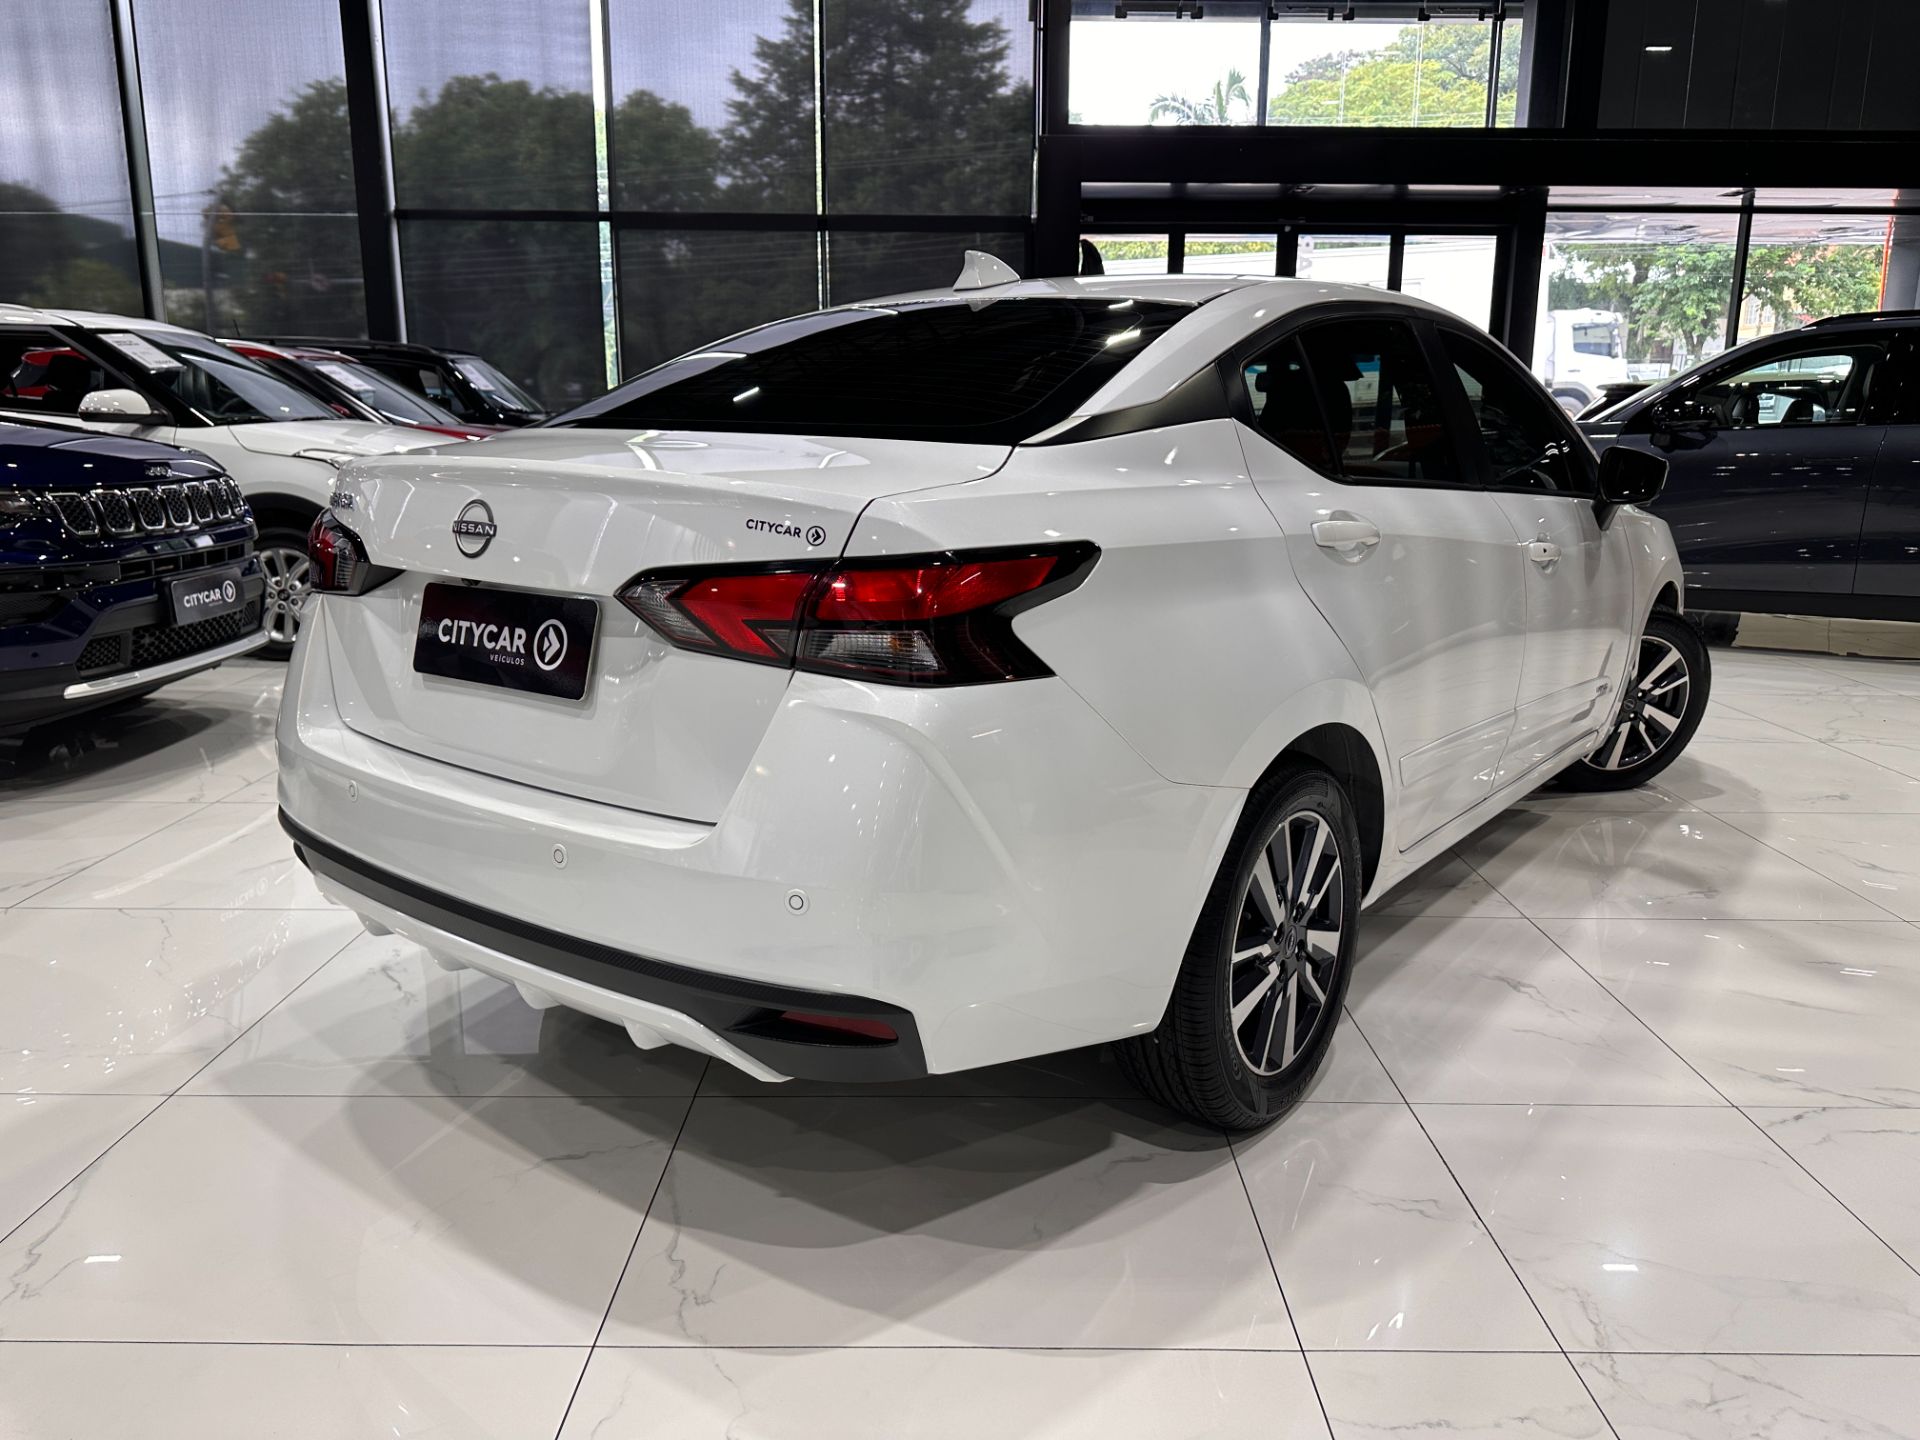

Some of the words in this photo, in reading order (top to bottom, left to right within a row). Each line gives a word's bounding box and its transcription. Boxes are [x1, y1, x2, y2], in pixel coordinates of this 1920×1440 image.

[452, 522, 495, 536] NISSAN
[745, 518, 802, 538] CITYCAR
[183, 588, 222, 608] CITYCAR
[438, 618, 527, 654] CITYCAR
